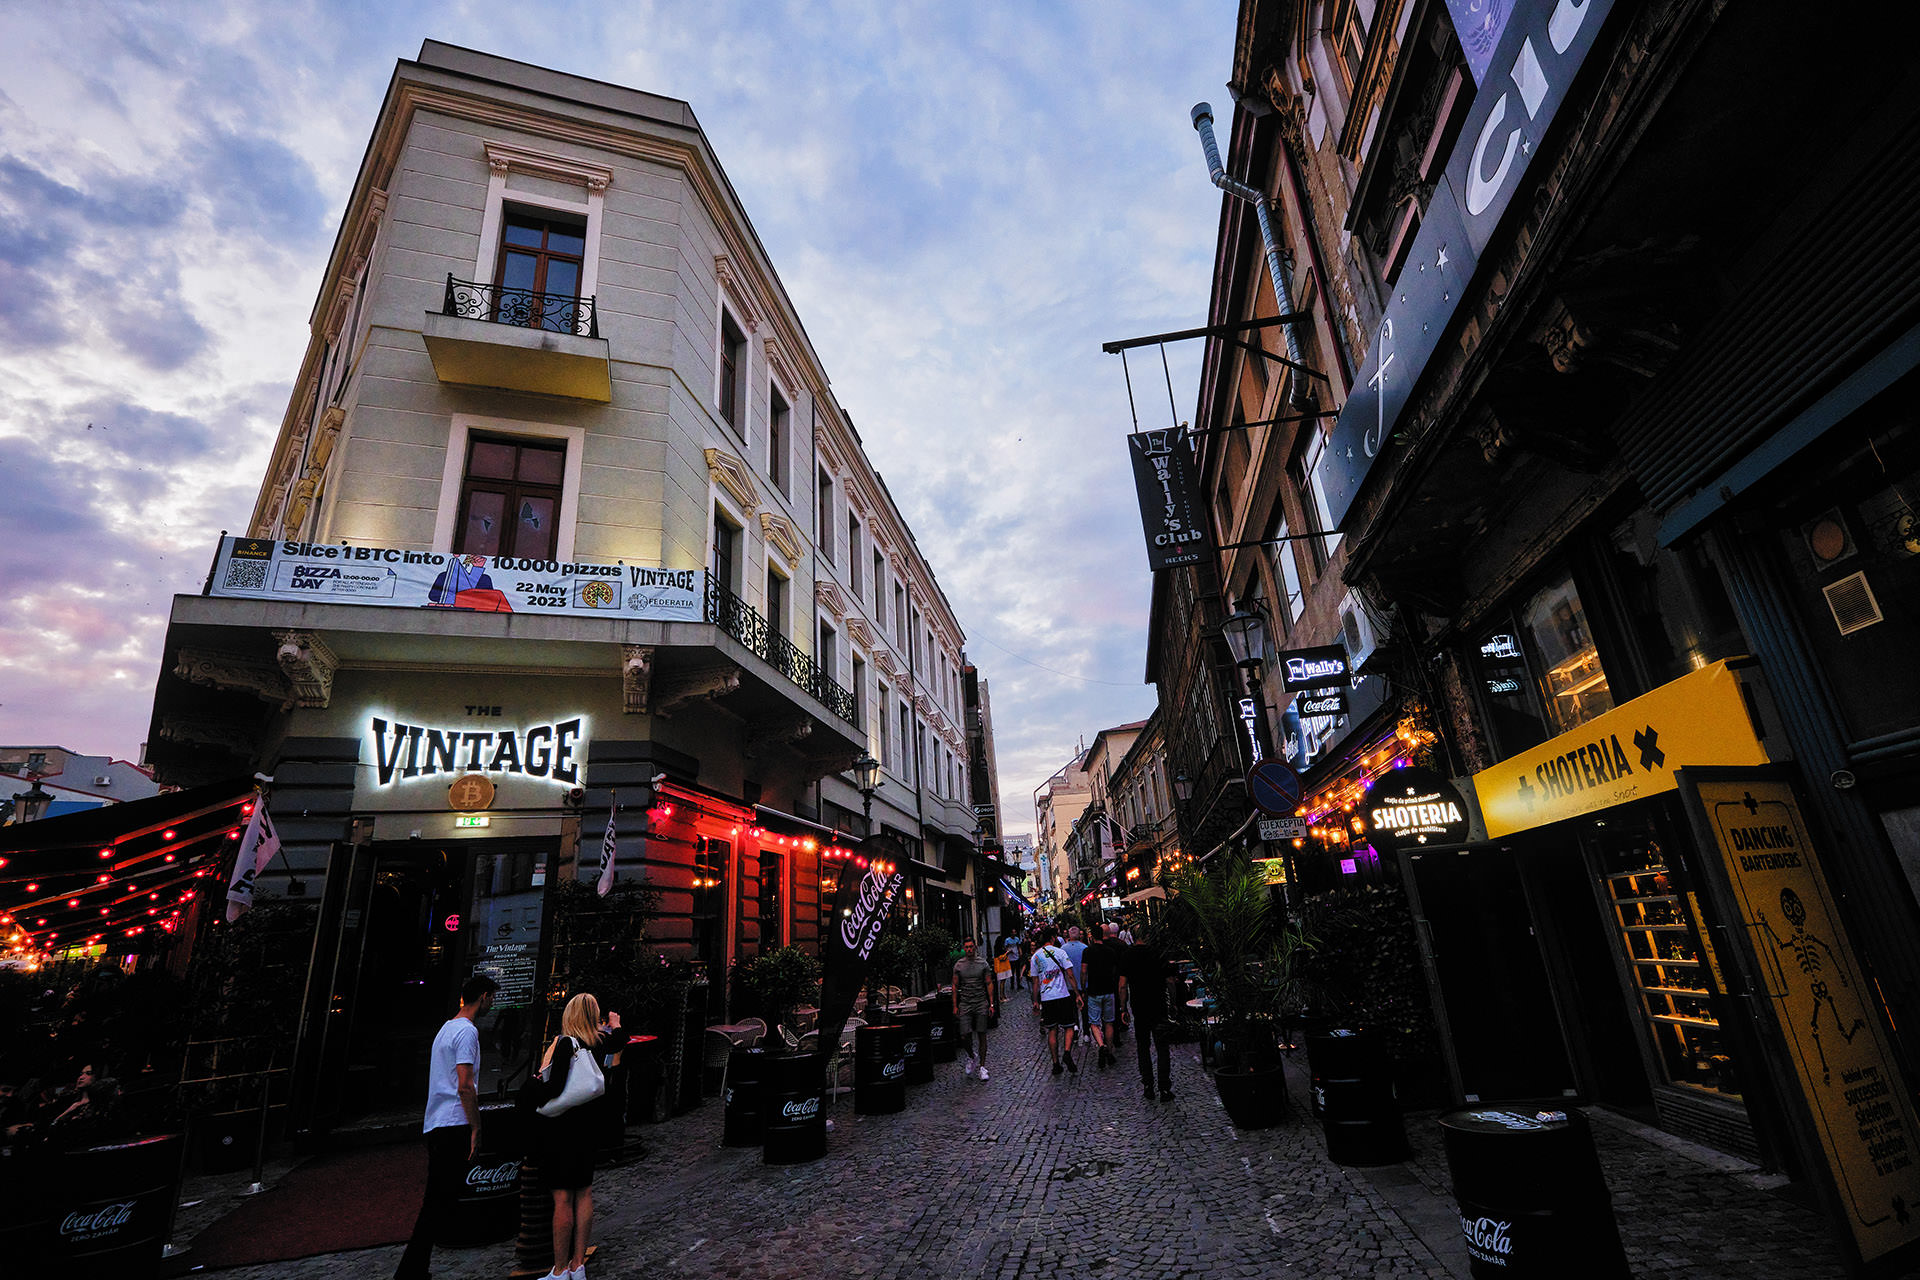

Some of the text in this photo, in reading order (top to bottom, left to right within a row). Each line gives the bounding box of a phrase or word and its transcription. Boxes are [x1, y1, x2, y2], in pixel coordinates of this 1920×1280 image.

[1155, 529, 1202, 546] Club
[237, 549, 268, 557] BINANCE
[282, 541, 445, 566] Slice 1 BTC into
[491, 557, 623, 578] 10.000 pizzas
[290, 578, 325, 590] DAY
[515, 582, 567, 596] 22 May
[630, 566, 695, 592] VINTAGE
[527, 596, 567, 608] 2023
[1305, 660, 1344, 675] Wally's
[465, 705, 502, 717] THE
[1304, 698, 1340, 713] Coca-Cola
[371, 717, 582, 786] VINTAGE
[1536, 734, 1633, 801] SHOTERIA
[1260, 821, 1270, 831] CU
[1372, 801, 1462, 830] SHOTERIA
[1730, 825, 1795, 851] DANCING
[1740, 852, 1802, 873] BARTENDERS
[841, 860, 887, 949] Coca-Cola
[877, 873, 905, 921] ZAHĂR
[783, 1097, 821, 1117] Coca-Cola
[466, 1161, 522, 1186] Coca-Cola
[60, 1199, 138, 1235] Coca-Cola
